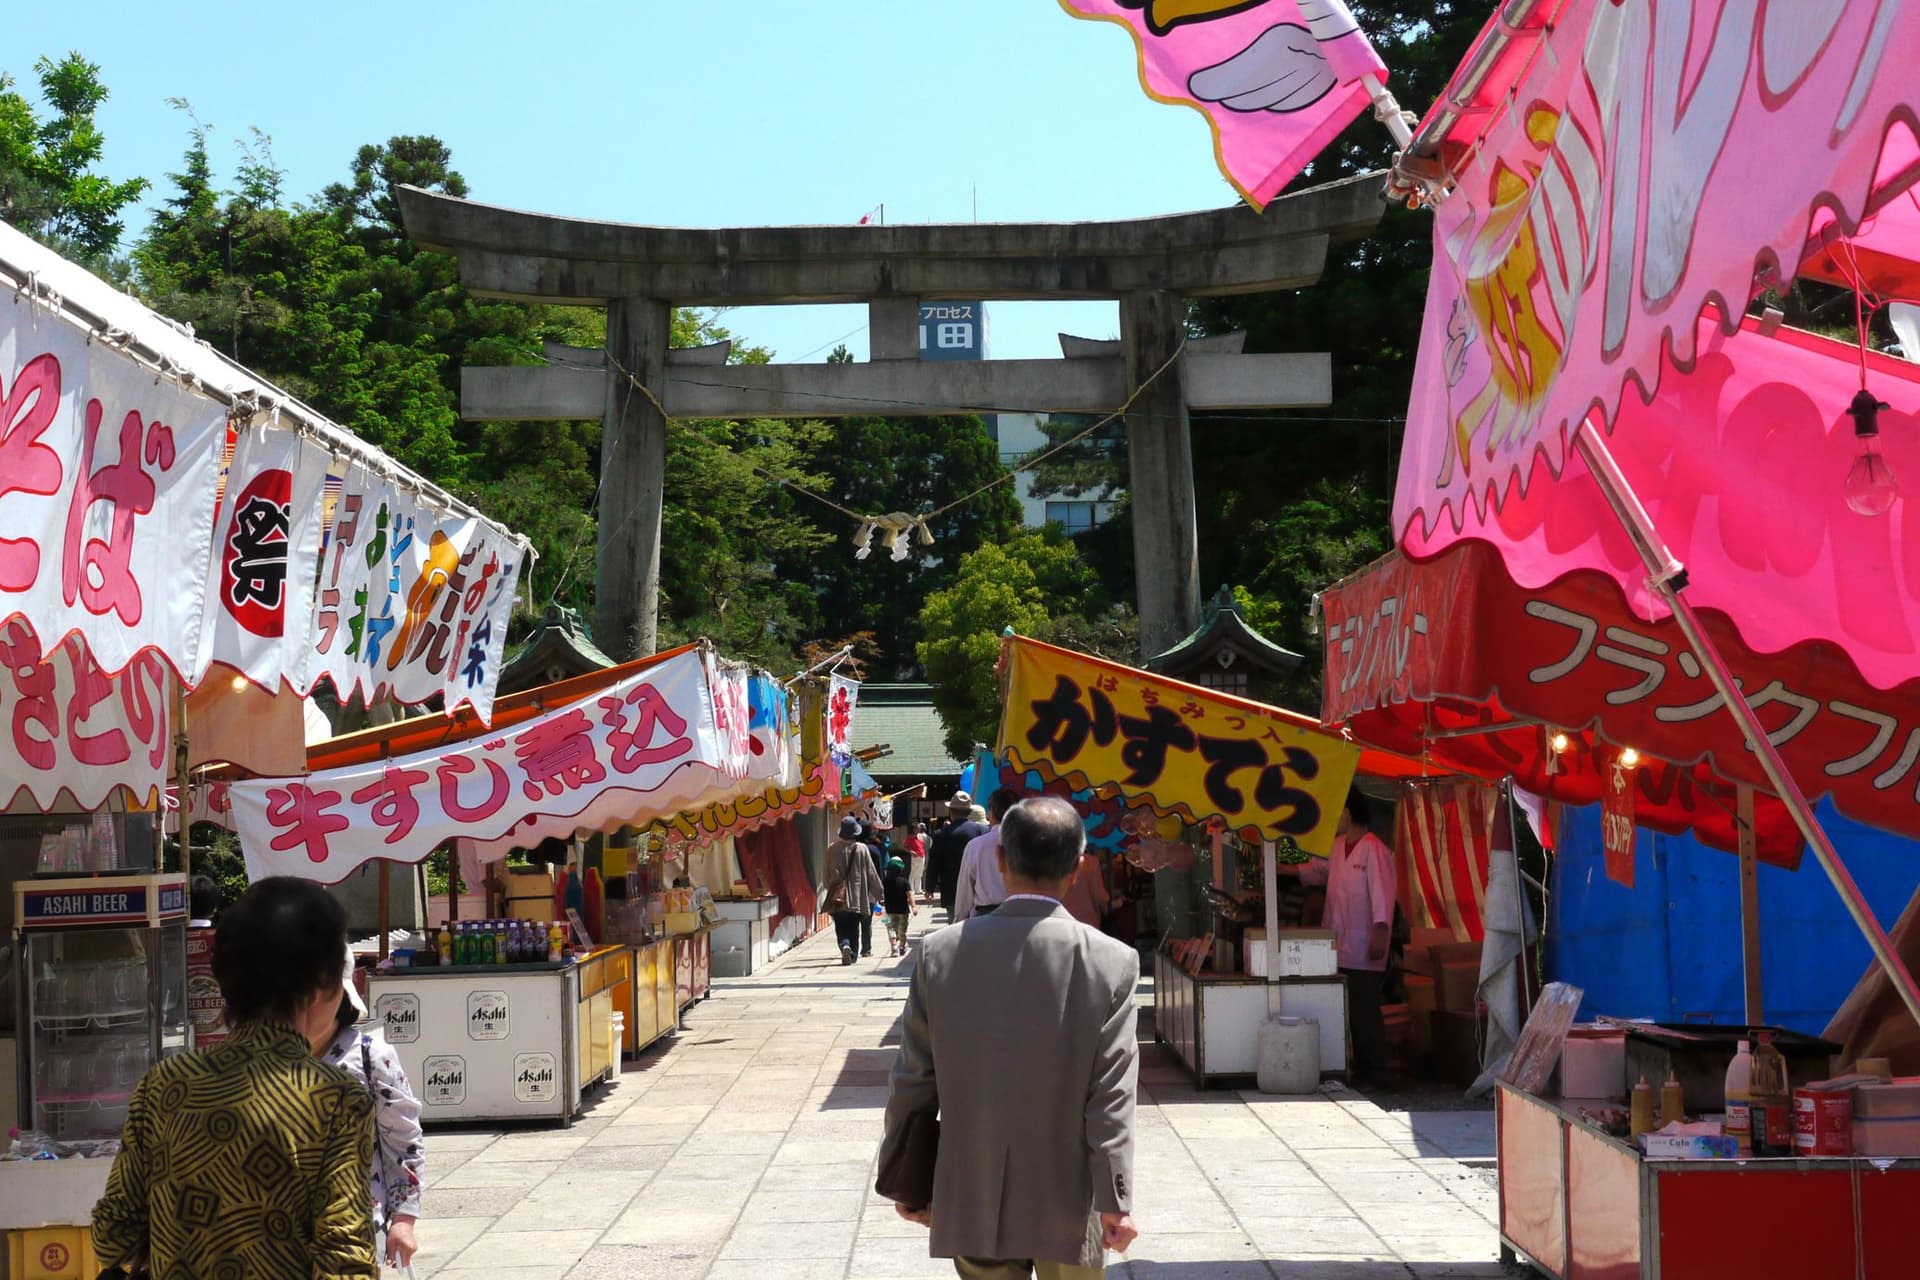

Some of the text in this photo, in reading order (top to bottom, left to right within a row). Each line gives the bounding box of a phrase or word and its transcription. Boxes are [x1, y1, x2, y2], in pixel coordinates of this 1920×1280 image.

[920, 323, 973, 349] 田
[921, 306, 972, 319] プロセス
[315, 494, 362, 655] コーラ
[345, 502, 391, 663] お茶
[363, 512, 414, 668] ジュース
[407, 539, 486, 675] ビール
[461, 563, 513, 689] ラムネ
[265, 683, 692, 863] 牛すじ煮込
[1026, 674, 1321, 834] かすてら
[43, 893, 128, 914] ASAHI BEER
[472, 1006, 506, 1020] Asahi
[518, 1068, 552, 1082] Asahi
[427, 1071, 462, 1086] Asahi
